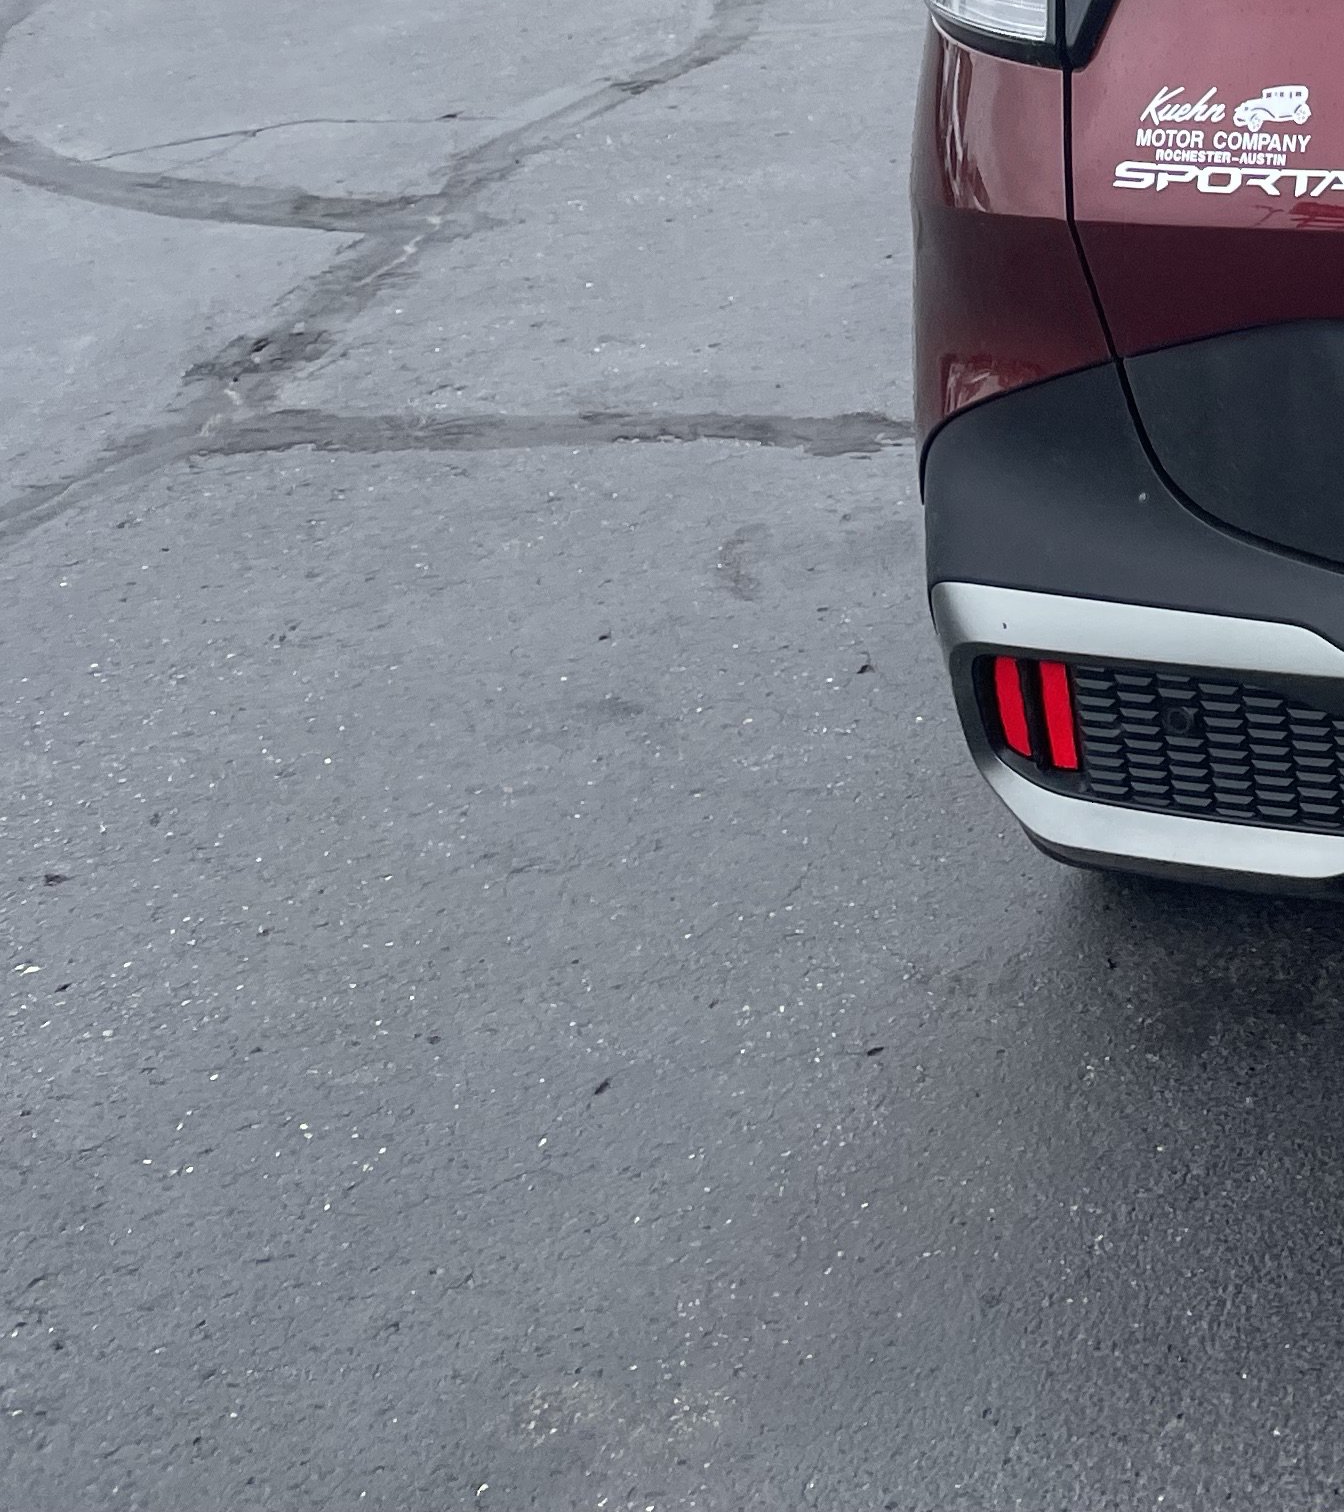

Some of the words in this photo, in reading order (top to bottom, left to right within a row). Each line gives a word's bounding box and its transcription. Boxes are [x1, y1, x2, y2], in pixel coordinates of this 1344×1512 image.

[1139, 85, 1226, 126] Kuehn
[1135, 128, 1205, 149] MOTOR
[1212, 130, 1312, 154] COMPANY
